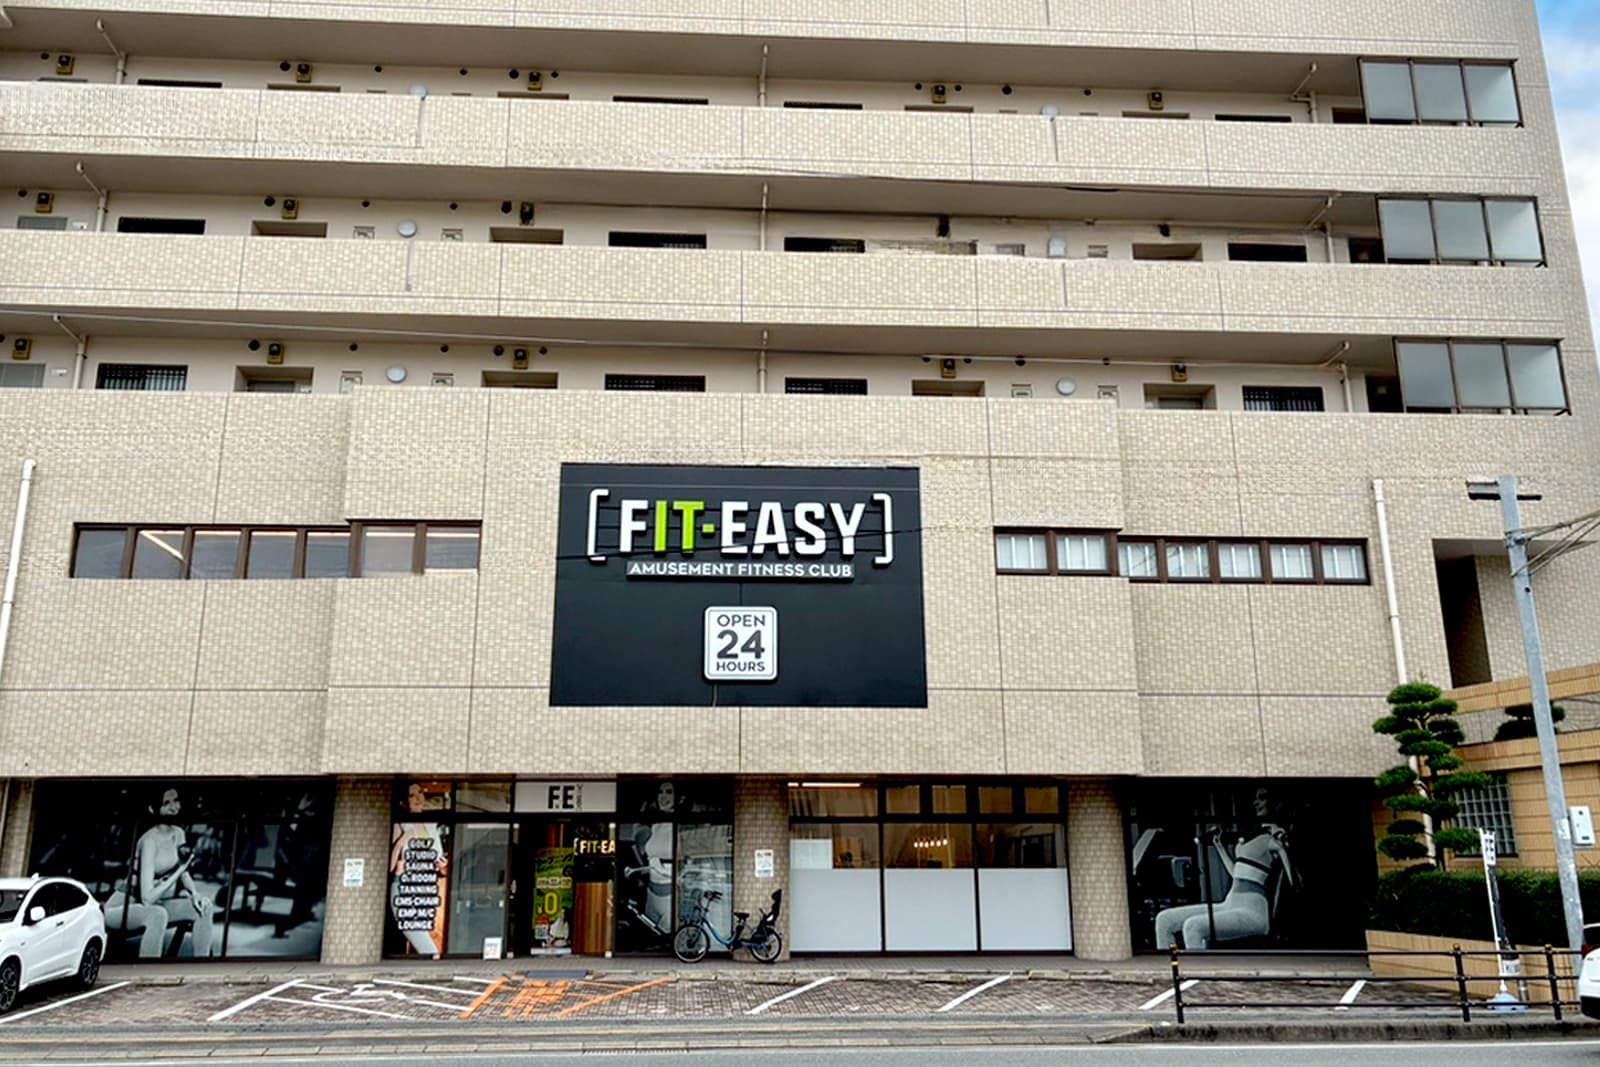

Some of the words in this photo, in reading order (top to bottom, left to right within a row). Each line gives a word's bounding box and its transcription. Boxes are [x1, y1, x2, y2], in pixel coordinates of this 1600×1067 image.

[629, 562, 735, 577] AMUSEMENT
[738, 563, 805, 577] FITNESS
[808, 564, 852, 578] CLUB
[716, 613, 766, 628] OPEN
[716, 629, 766, 660] 24
[716, 661, 766, 673] HOURS
